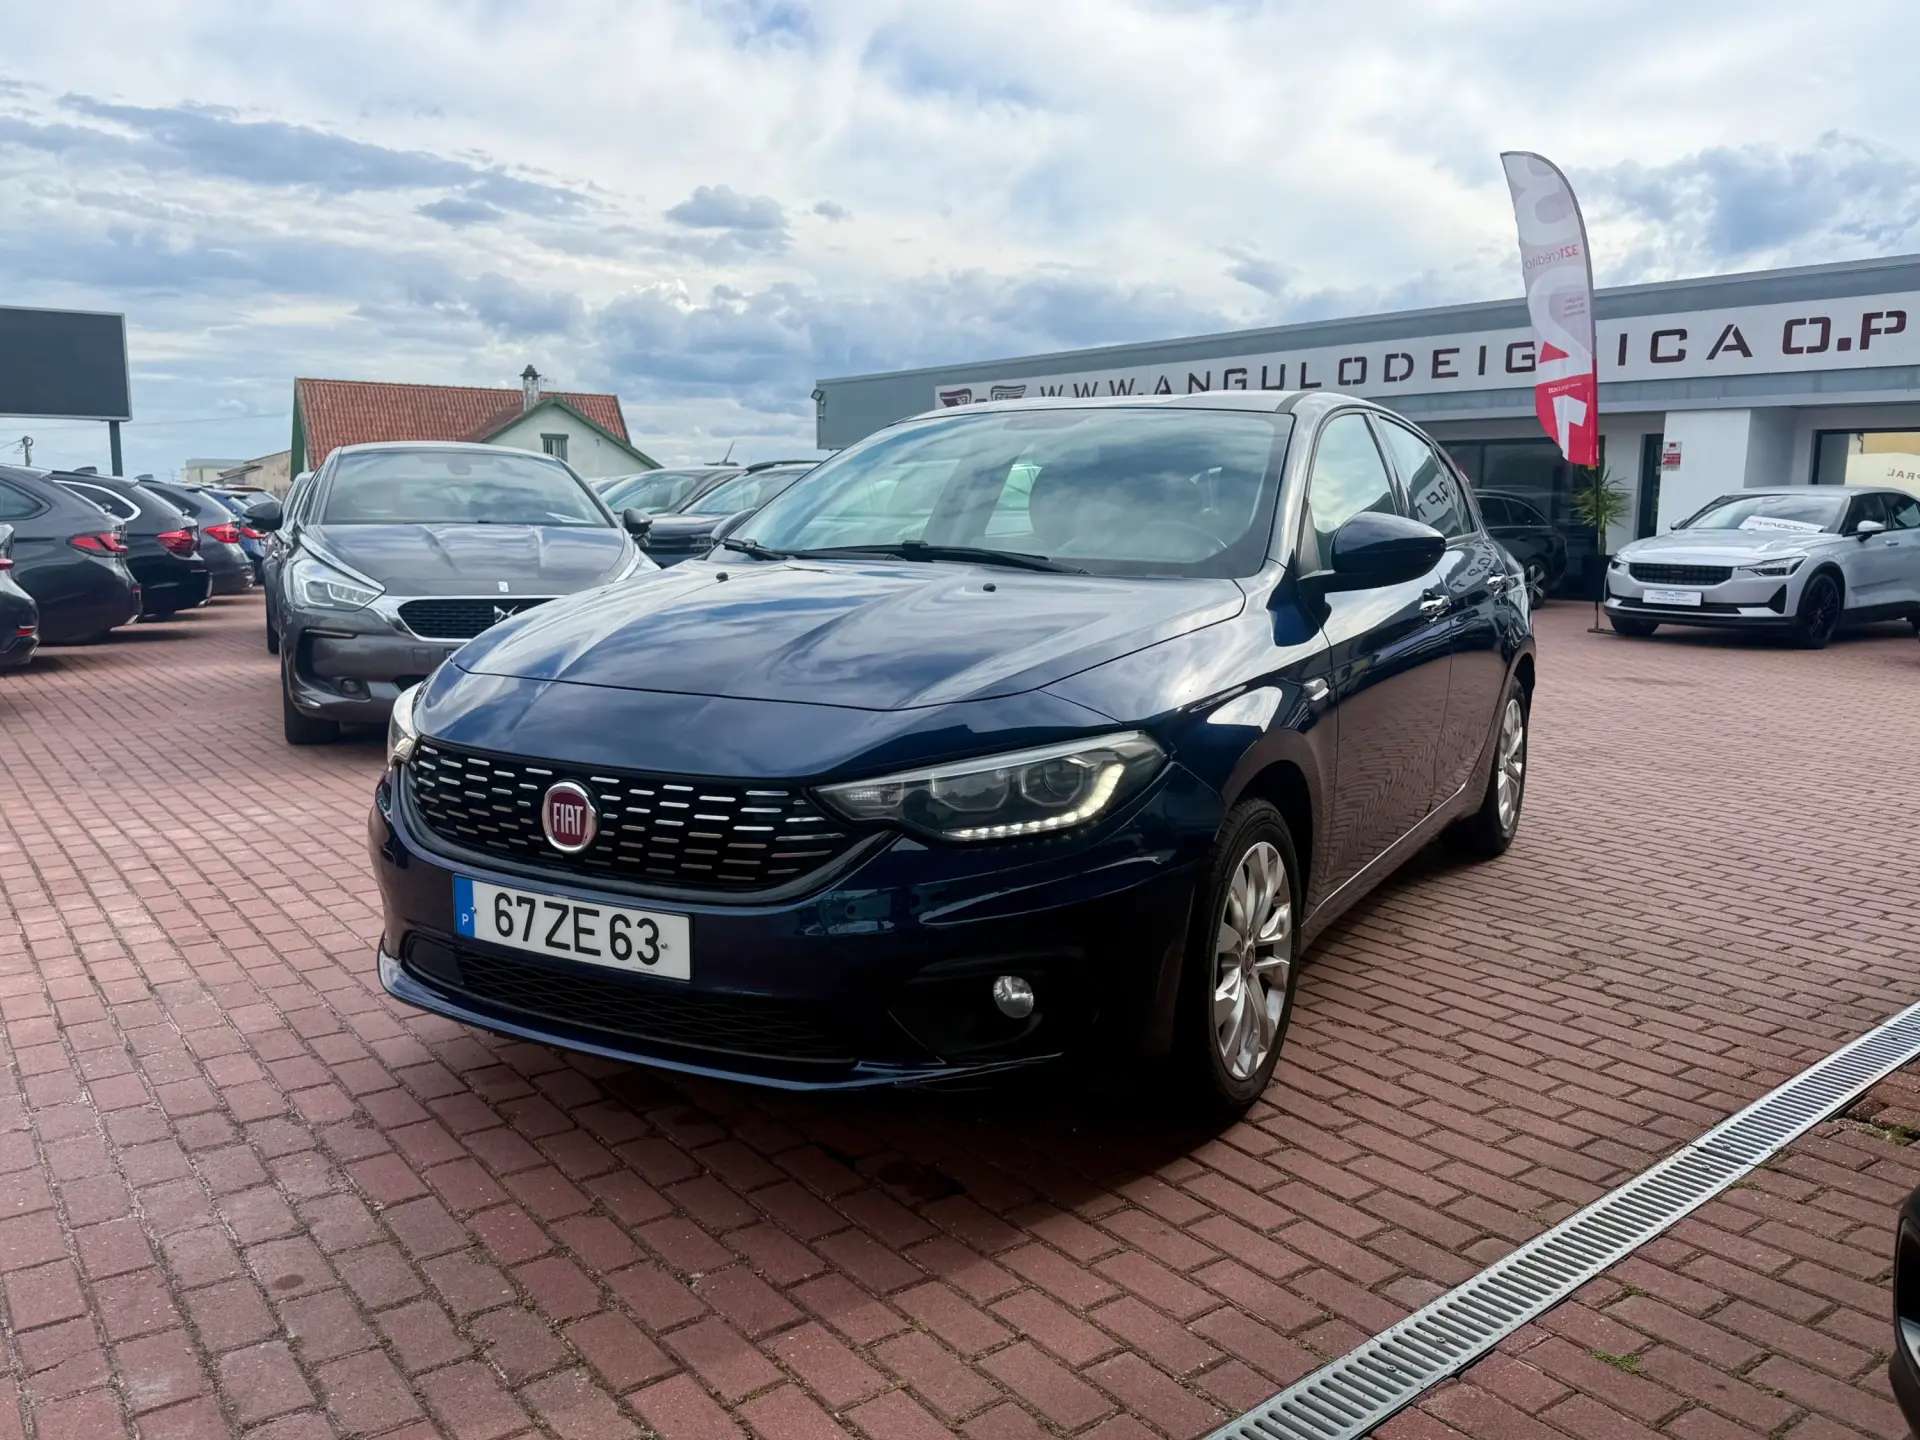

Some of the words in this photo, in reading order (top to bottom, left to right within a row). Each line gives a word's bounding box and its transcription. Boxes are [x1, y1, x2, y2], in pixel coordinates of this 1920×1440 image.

[1040, 310, 1907, 398] WWW.ANGULODEIGICAO.P
[553, 802, 584, 836] FIAT
[461, 913, 469, 926] P
